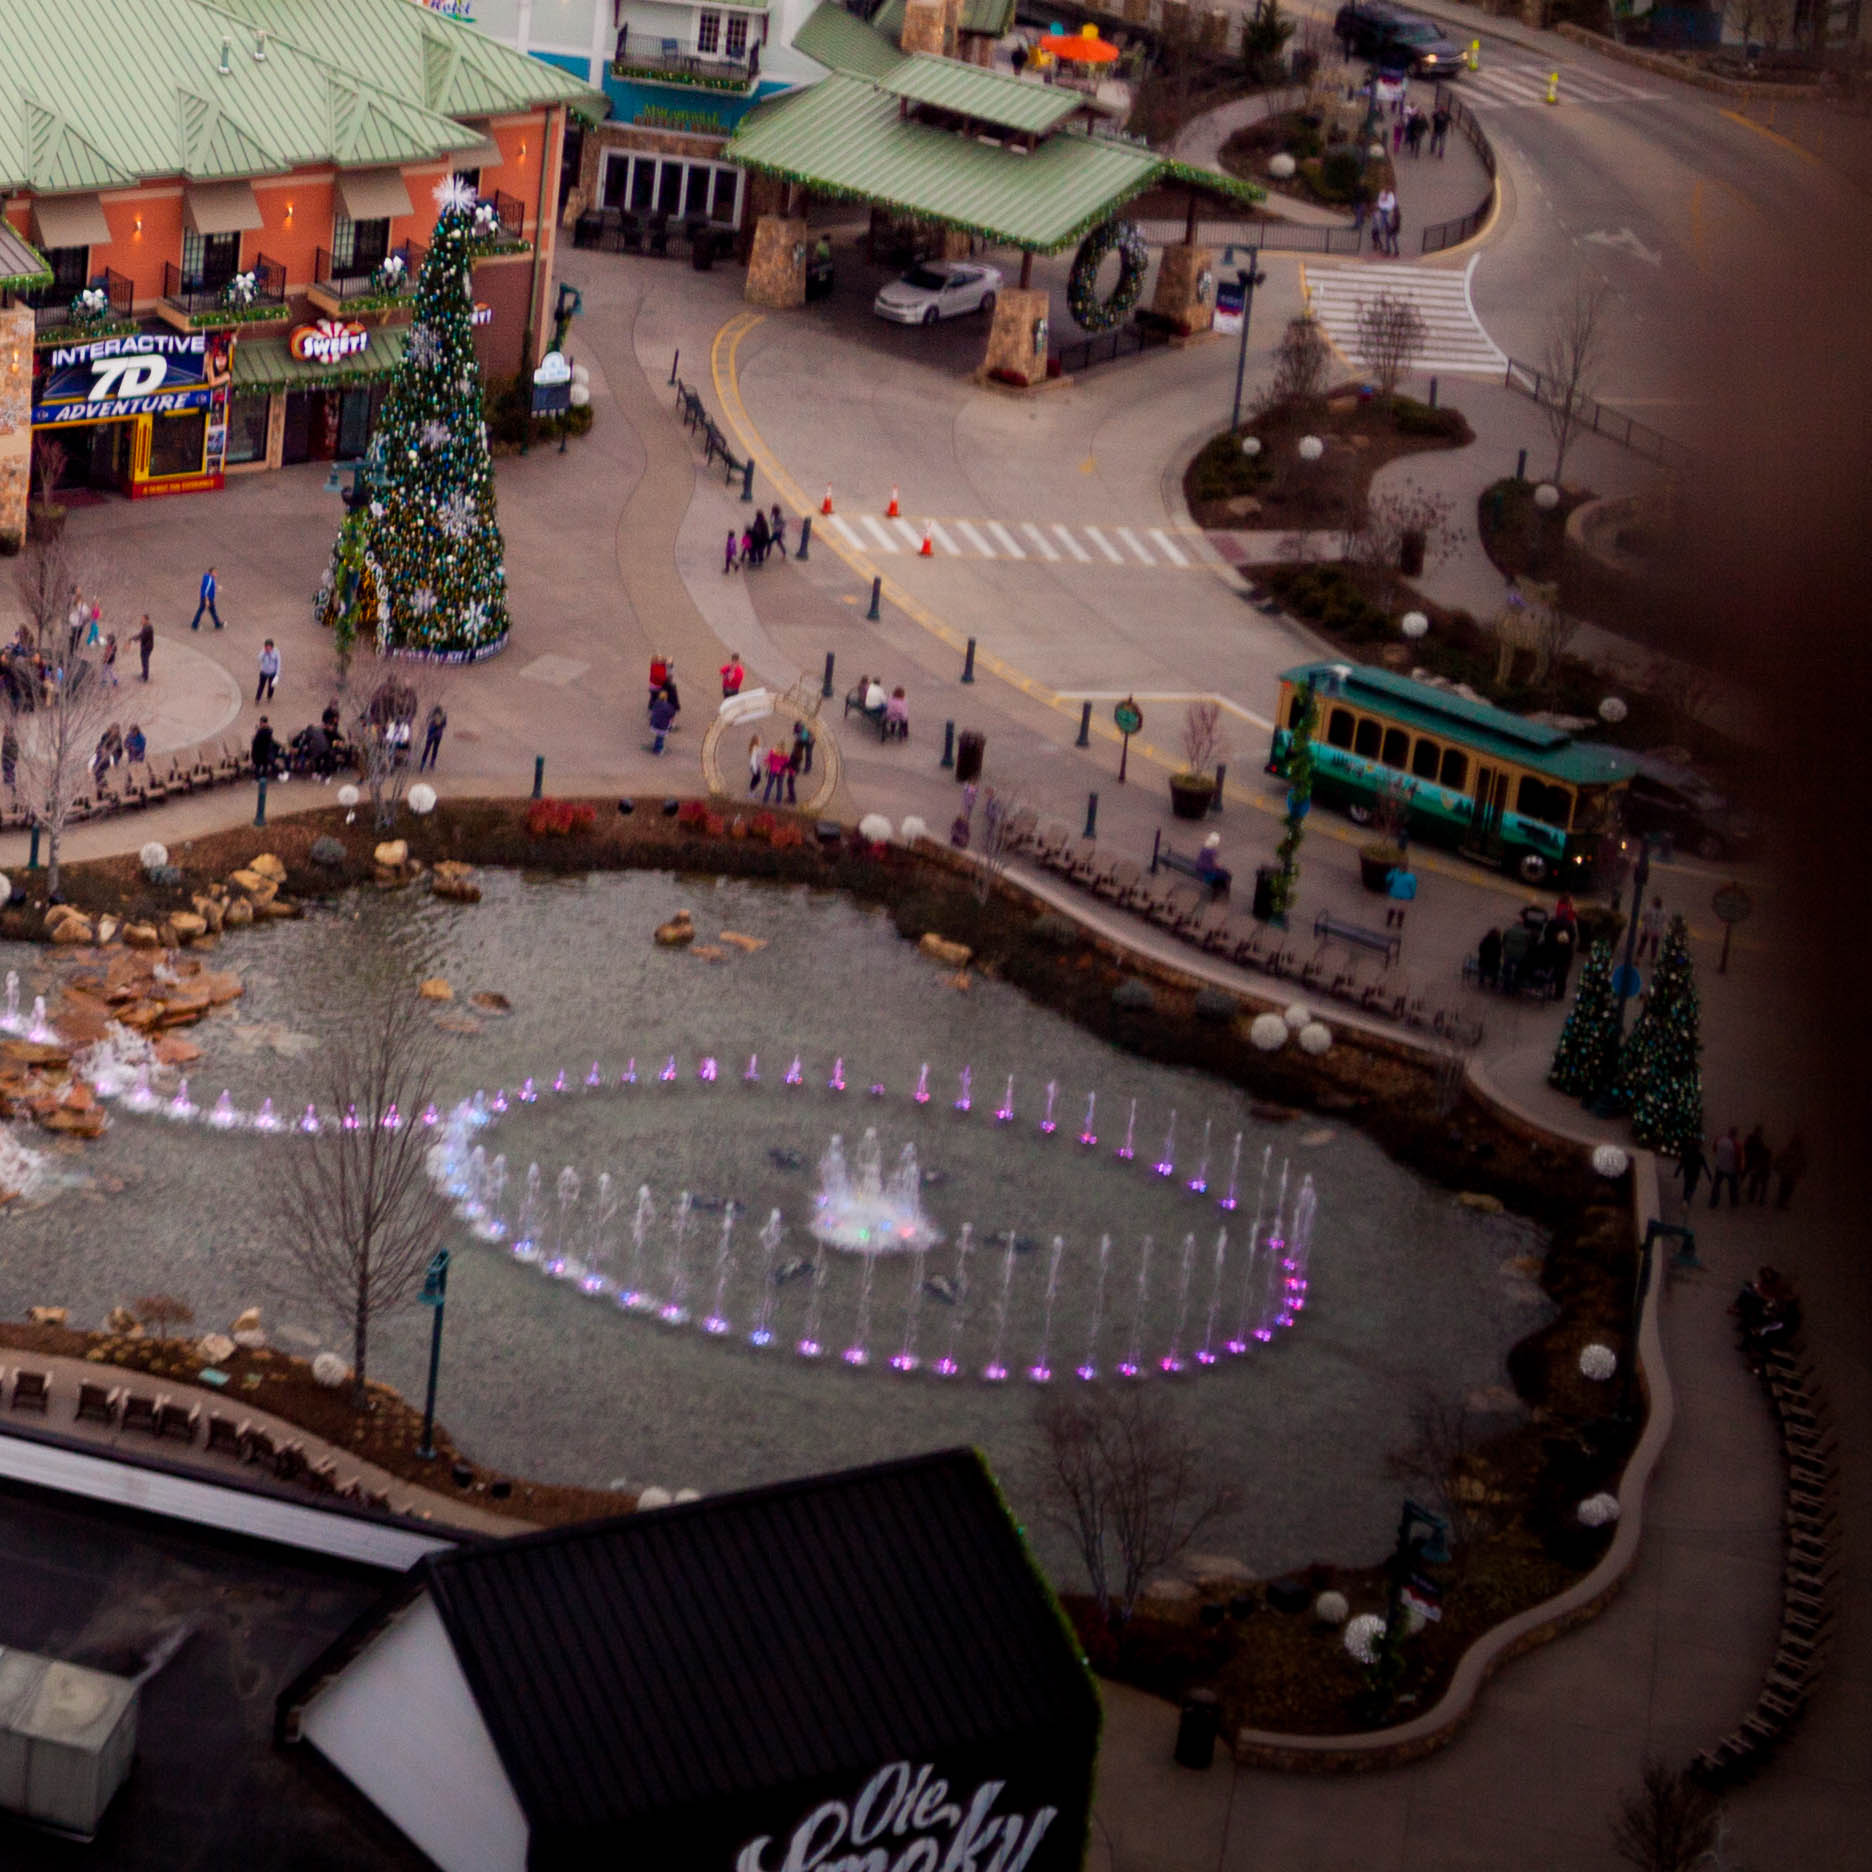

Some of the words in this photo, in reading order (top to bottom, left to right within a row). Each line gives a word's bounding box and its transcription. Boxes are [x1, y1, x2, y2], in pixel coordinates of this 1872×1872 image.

[51, 335, 205, 366] INTERACTIVE
[303, 330, 368, 358] SWEET!
[88, 354, 168, 402] 7D
[54, 392, 190, 422] ADVENTURE
[851, 1761, 961, 1846] Ole
